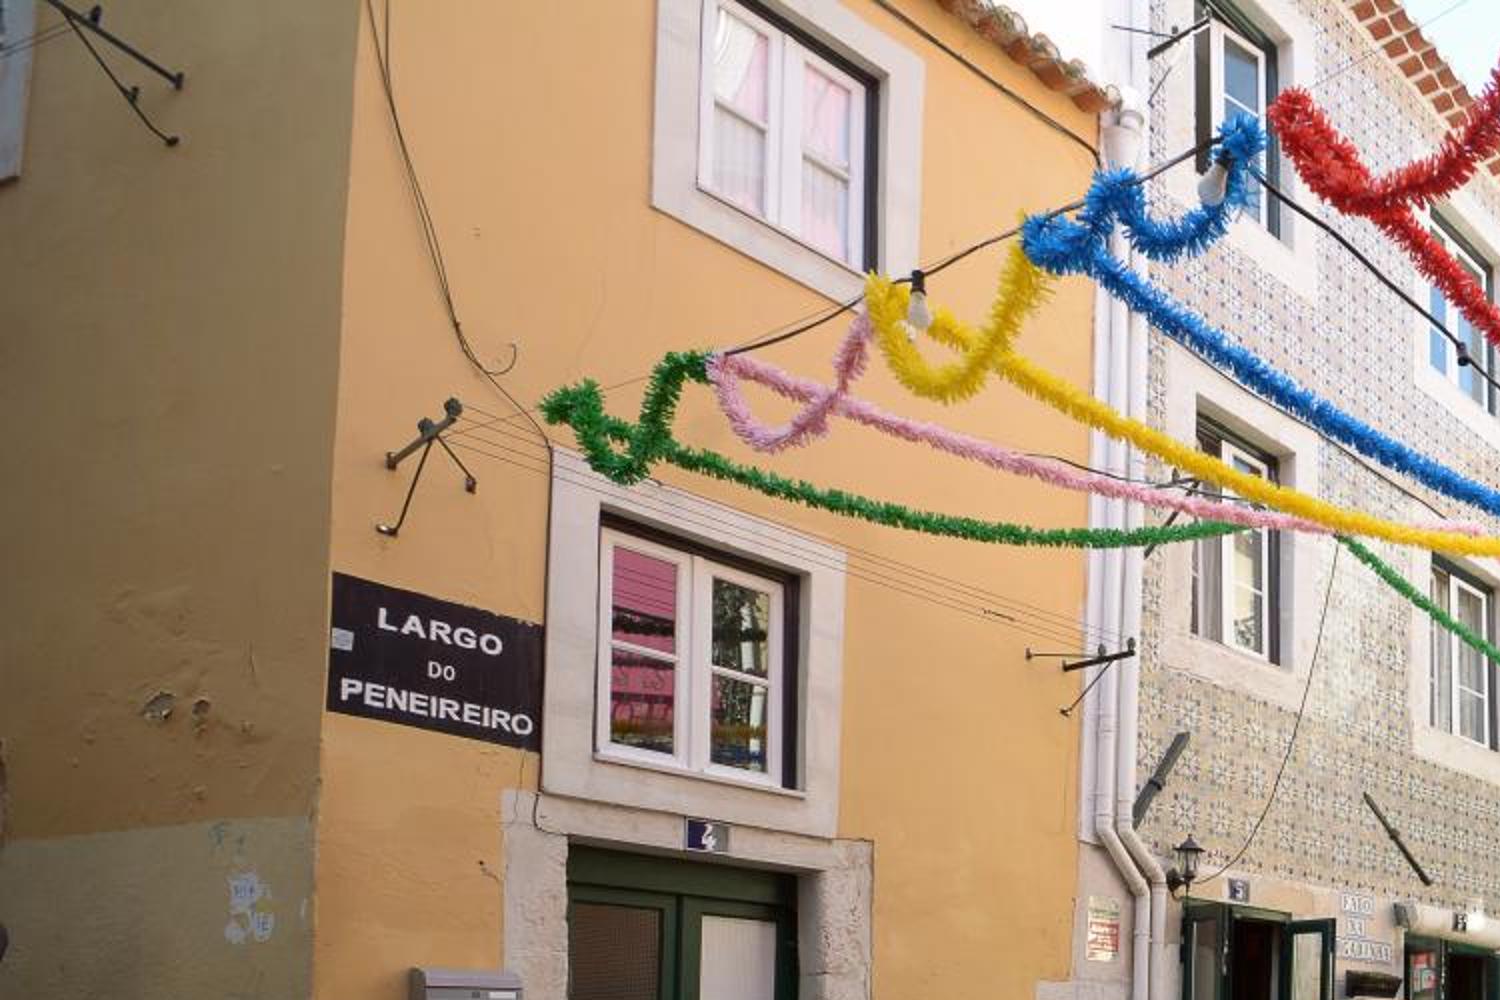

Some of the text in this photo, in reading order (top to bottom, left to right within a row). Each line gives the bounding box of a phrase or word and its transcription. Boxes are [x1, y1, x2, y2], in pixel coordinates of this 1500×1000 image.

[377, 607, 504, 656] LARGO
[427, 661, 456, 681] DO
[340, 677, 534, 736] PENEIREIRO
